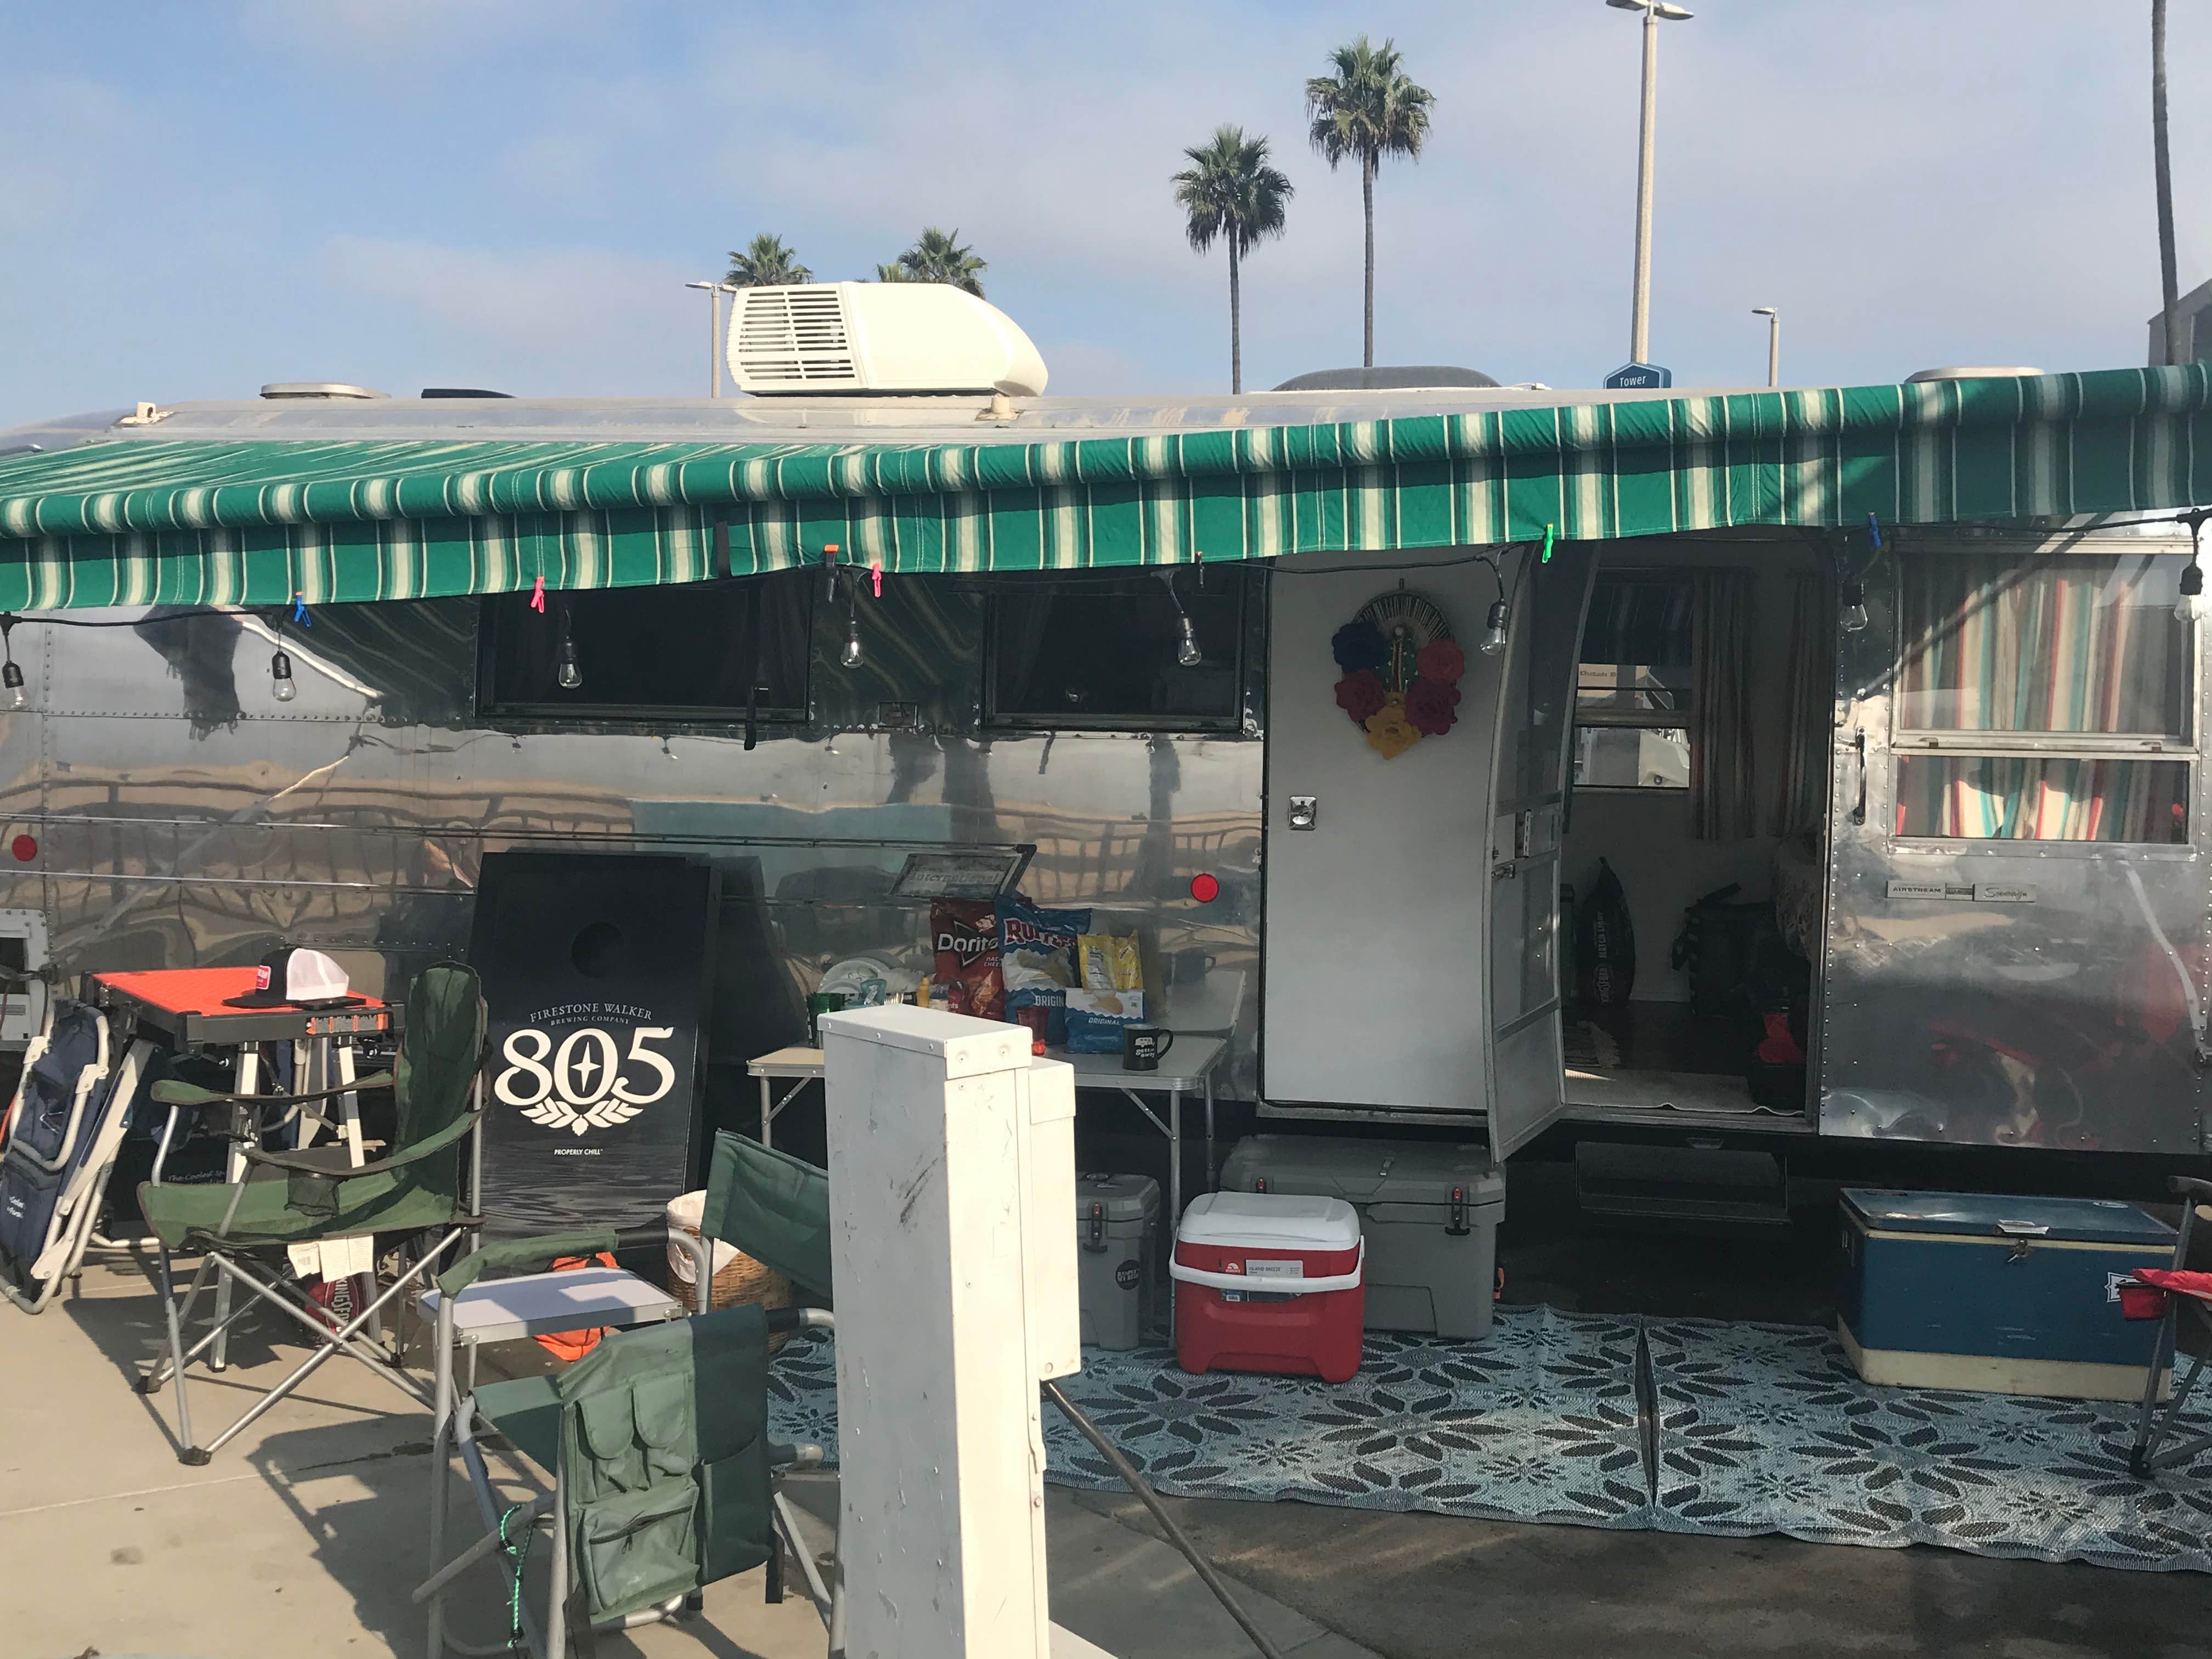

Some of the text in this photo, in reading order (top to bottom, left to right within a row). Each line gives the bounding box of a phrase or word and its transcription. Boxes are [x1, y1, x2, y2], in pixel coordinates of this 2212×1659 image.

[1620, 376, 1646, 387] Tower
[938, 933, 998, 952] Dorito
[1035, 995, 1064, 1008] ORIGIN
[529, 1003, 652, 1023] FIRESTONE WALKER
[550, 1015, 630, 1026] BREWING COMPANY
[1088, 1017, 1121, 1026] ORIGINAL
[494, 1026, 675, 1106] 805
[331, 1277, 353, 1323] KINGSFO
